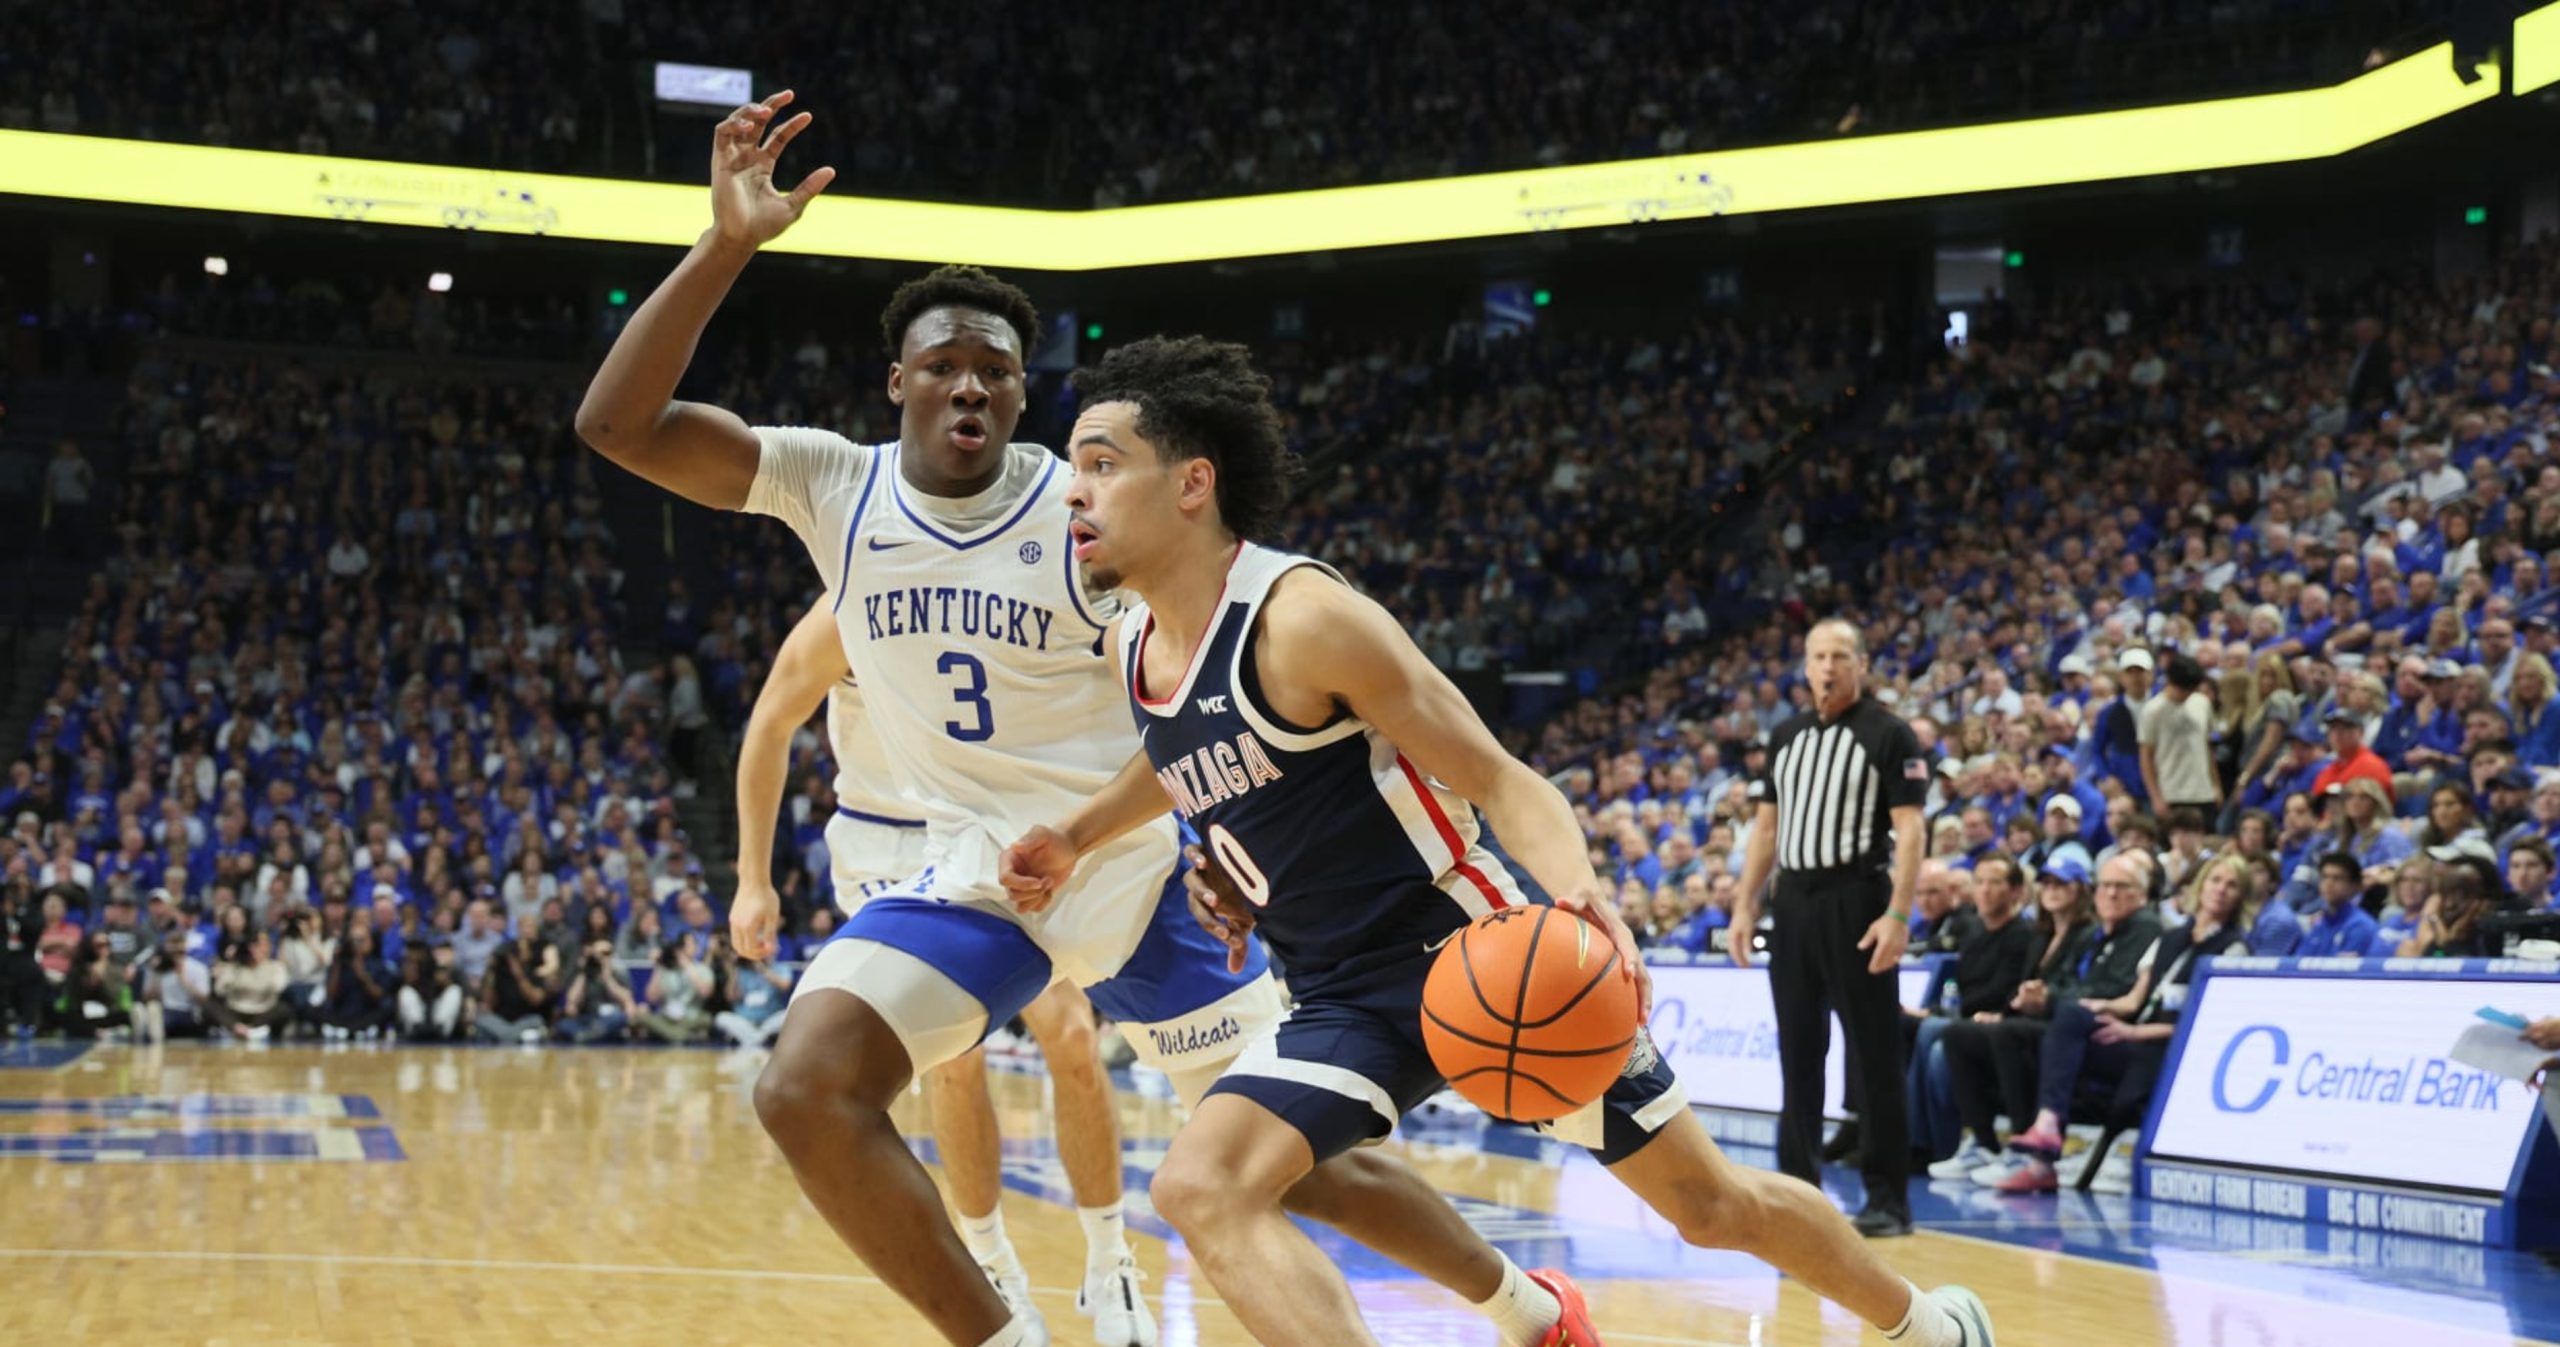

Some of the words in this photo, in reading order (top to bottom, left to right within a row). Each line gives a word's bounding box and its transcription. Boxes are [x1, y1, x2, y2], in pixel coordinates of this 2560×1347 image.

[1020, 543, 1041, 563] SEC
[865, 587, 1053, 650] KENTUCKY
[937, 651, 995, 741] 3
[1157, 731, 1284, 821] NZAGA
[1209, 823, 1270, 907] 0
[1149, 1016, 1240, 1056] Wildcats
[2211, 1025, 2290, 1113] C
[2297, 1052, 2415, 1103] Central
[2415, 1058, 2504, 1111] Bank
[2151, 1167, 2213, 1205] KENTUCKY
[2215, 1174, 2251, 1210] FARM
[2253, 1180, 2306, 1218] BUREAU
[2328, 1188, 2354, 1224] BIG
[2356, 1192, 2380, 1228] ON
[2381, 1195, 2486, 1243] COMMITMENT
